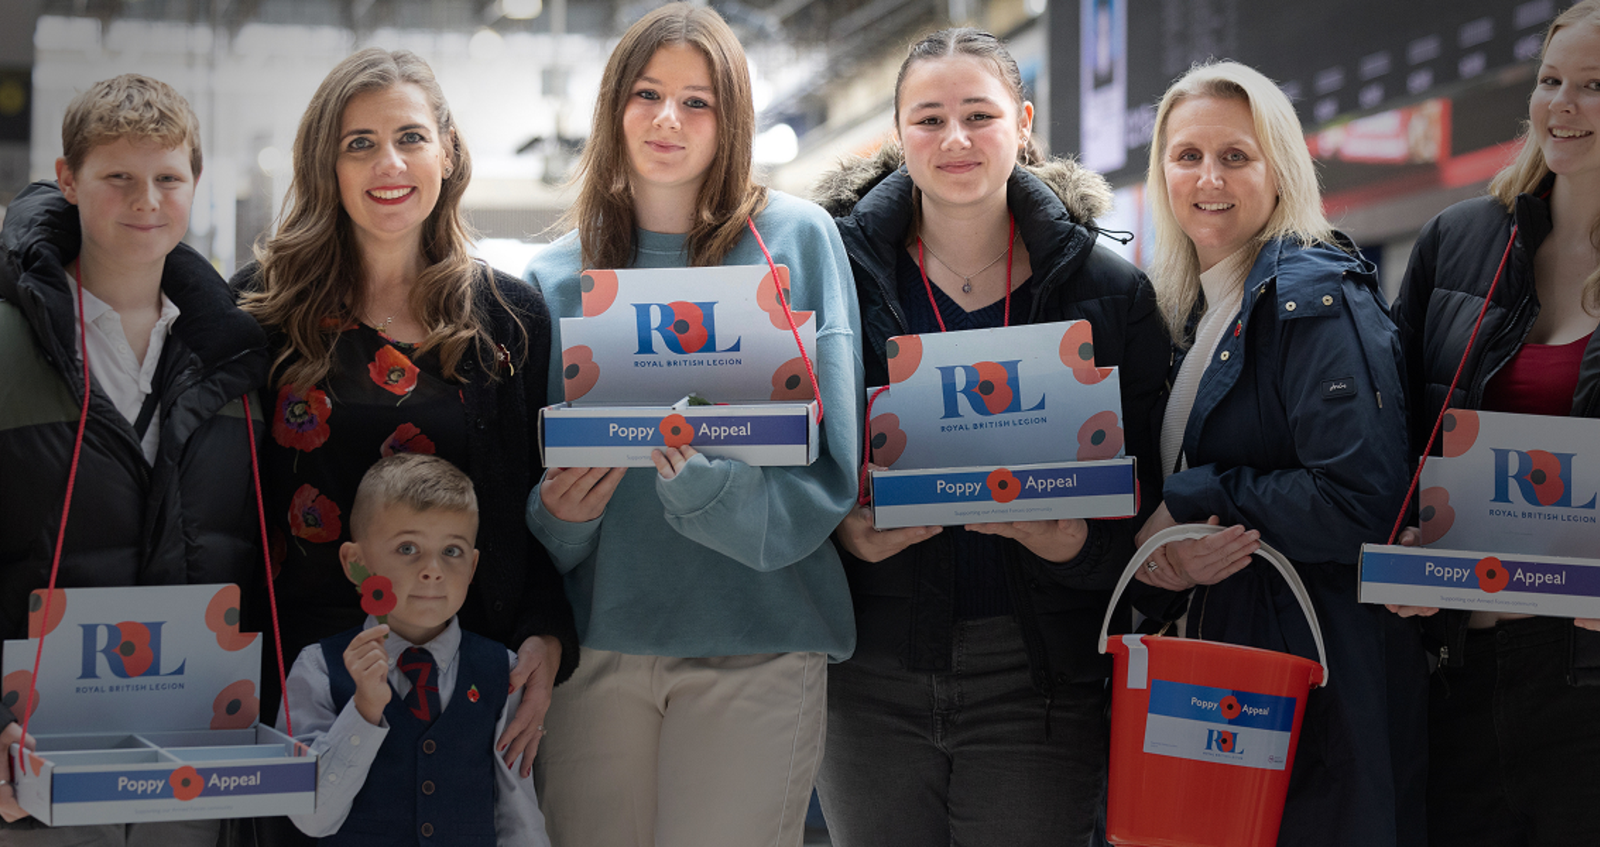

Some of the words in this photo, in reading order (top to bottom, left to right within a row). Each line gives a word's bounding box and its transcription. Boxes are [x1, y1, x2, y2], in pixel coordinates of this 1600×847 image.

[667, 359, 704, 367] BRITISH
[707, 358, 742, 366] LEGION
[609, 423, 655, 440] Poppy
[698, 422, 751, 439] Appeal
[940, 424, 970, 432] ROYAL
[973, 421, 1010, 430] BRITISH
[1012, 417, 1047, 426] LEGION
[936, 480, 982, 496] Poppy
[1025, 474, 1077, 492] Appeal
[1489, 509, 1518, 518] ROYAL
[1521, 511, 1558, 521] BRITISH
[1561, 514, 1596, 524] LEGION
[1425, 562, 1470, 582] Poppy
[1513, 568, 1566, 587] Appeal
[76, 686, 106, 694] ROYAL
[109, 684, 147, 692] BRITISH
[149, 682, 185, 691] LEGION
[1191, 697, 1218, 711] Poppy
[1242, 704, 1270, 716] Appeal
[118, 776, 165, 795] Poppy
[208, 772, 260, 790] Appeal
